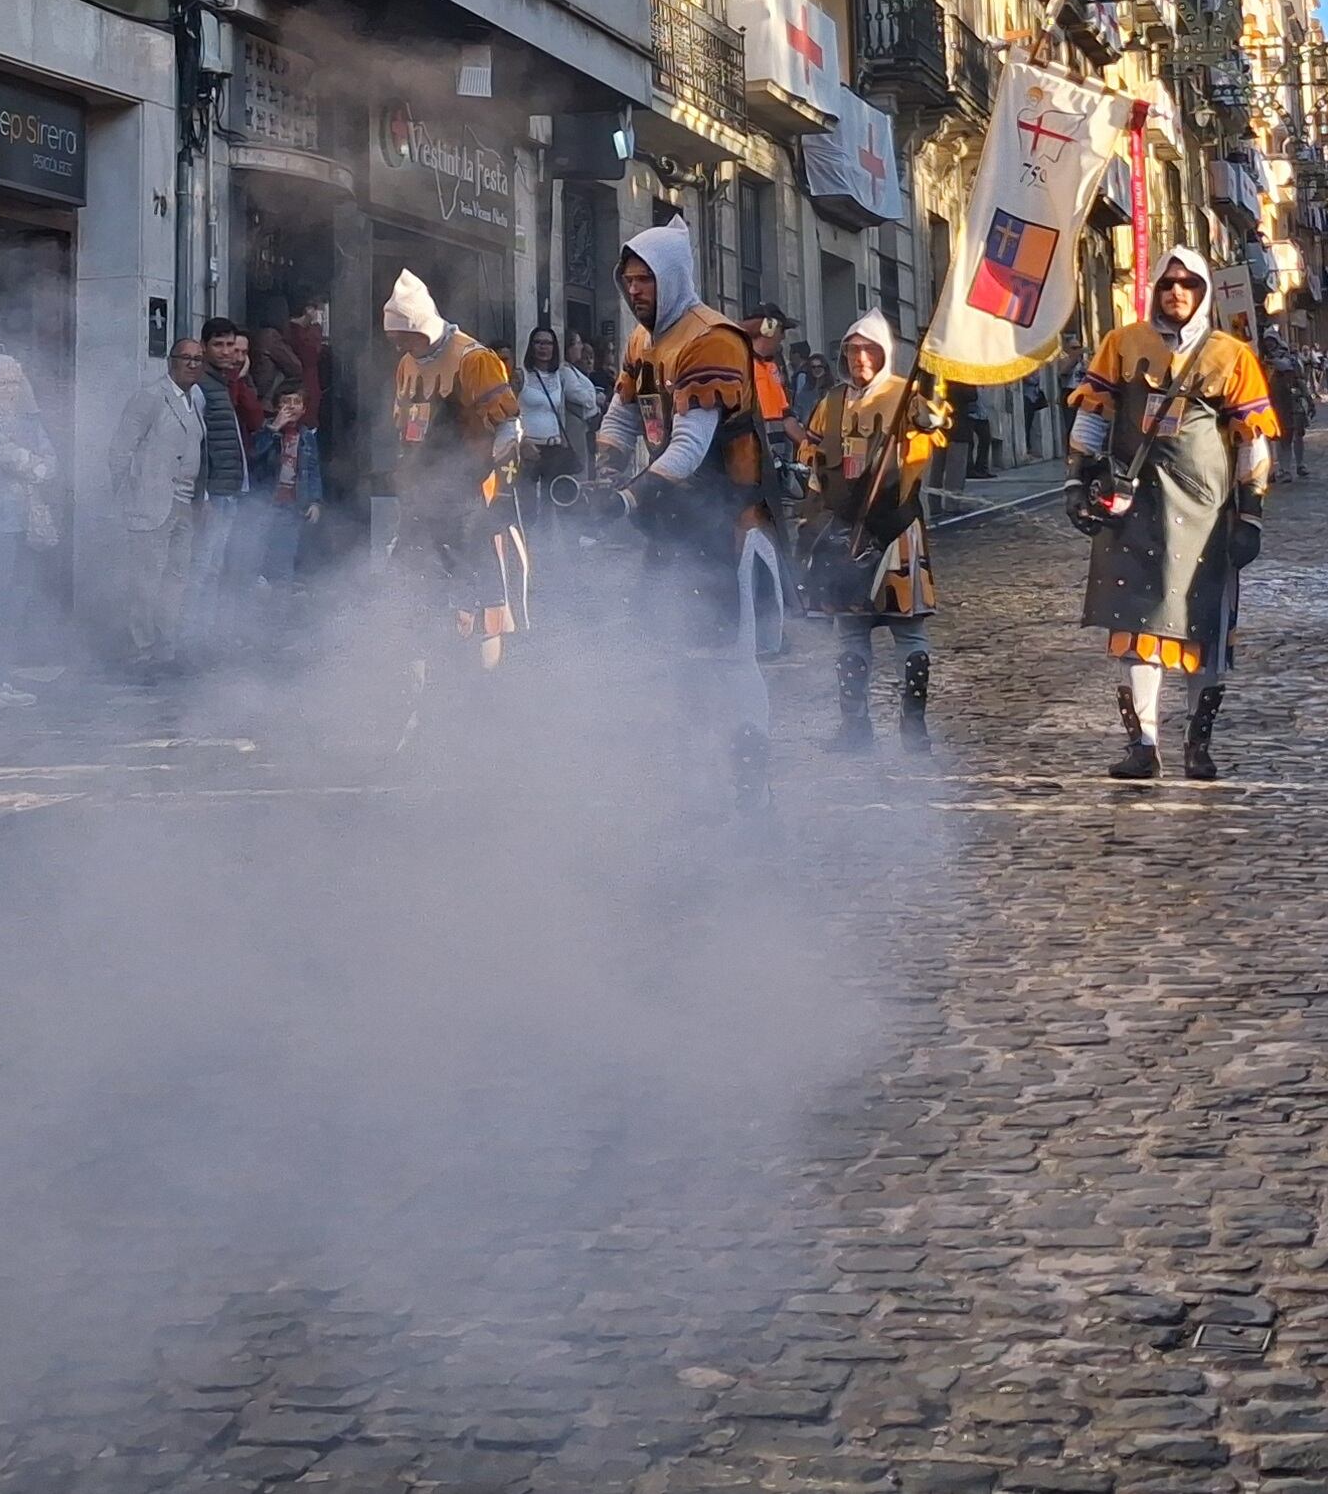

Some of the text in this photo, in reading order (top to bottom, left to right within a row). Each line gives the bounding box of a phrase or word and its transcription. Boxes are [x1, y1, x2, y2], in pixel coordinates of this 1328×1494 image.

[463, 146, 474, 183] la
[475, 149, 509, 197] Festa
[1019, 162, 1047, 187] 750
